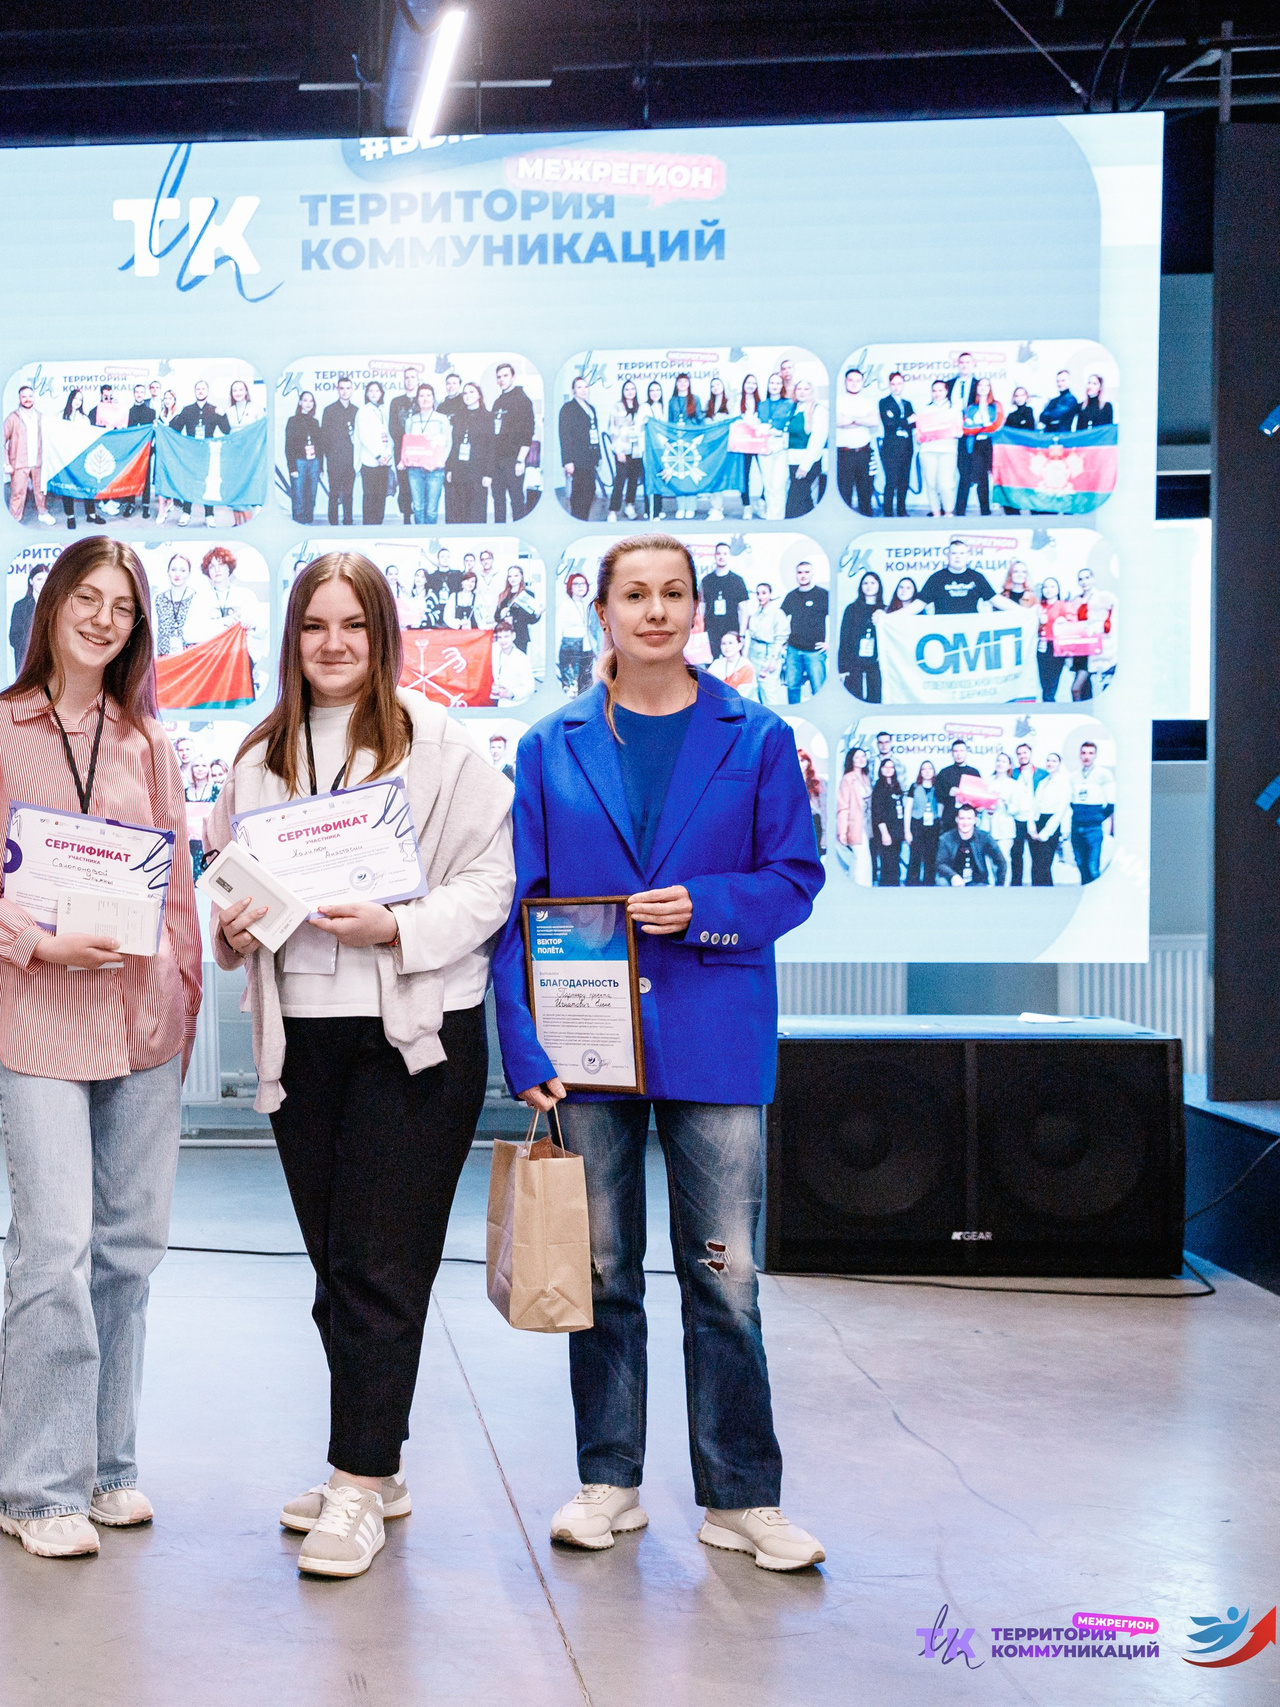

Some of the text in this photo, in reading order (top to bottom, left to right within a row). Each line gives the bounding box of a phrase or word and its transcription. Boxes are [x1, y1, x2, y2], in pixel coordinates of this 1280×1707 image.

[518, 155, 714, 190] МЕЖРЕГИОН
[300, 188, 616, 227] ТЕРРИТОРИЯ
[300, 219, 726, 270] КОММУНИКАЦИЙ
[885, 546, 984, 558] ТЕРРИТОИЯ
[914, 627, 1023, 676] ОМП
[277, 814, 369, 843] СЕРТИФИКАТ
[305, 833, 341, 845] УЧАСТНИКА
[45, 838, 132, 863] СЕРТИФИКАТ
[67, 854, 101, 866] УЧАСТНИКА
[537, 938, 563, 946] ВЕКТОР
[537, 945, 565, 954] ПОЛЁТА
[539, 978, 620, 988] БЛАГОДАРНОСТЬ
